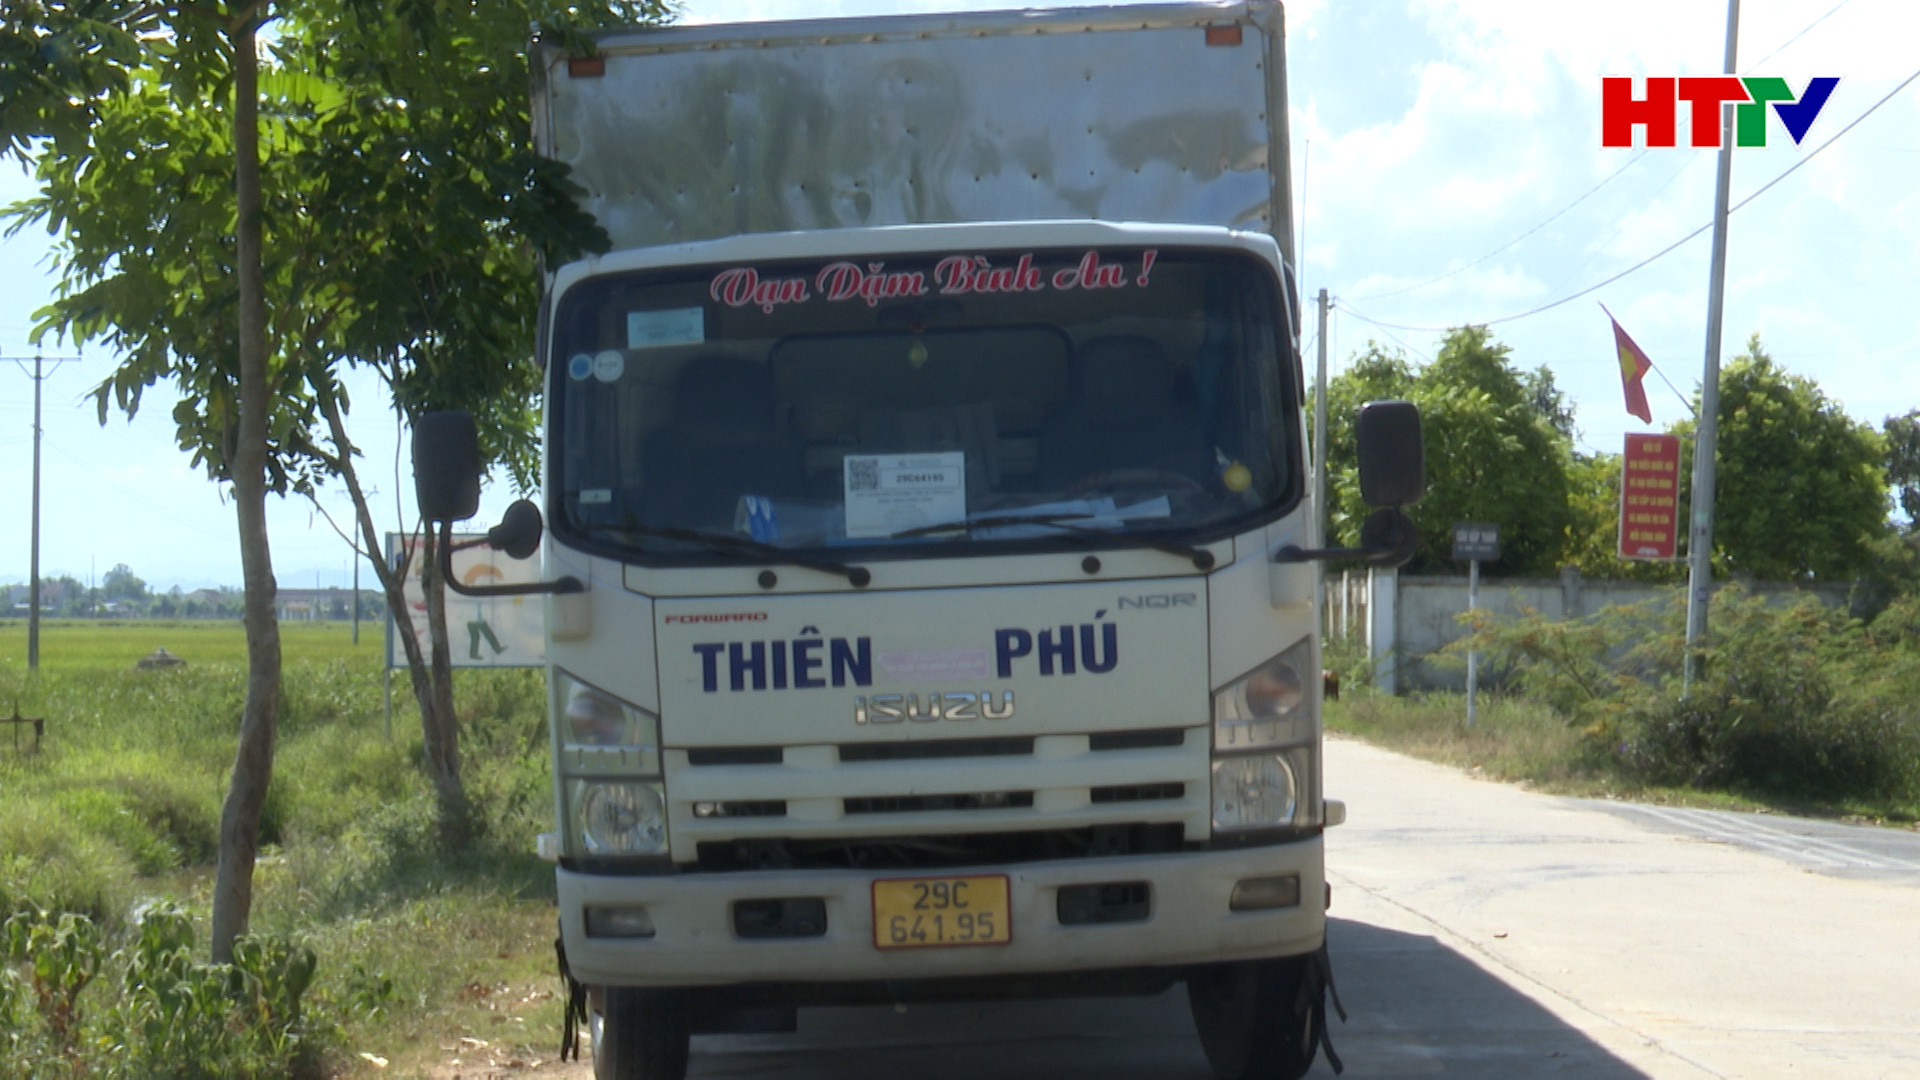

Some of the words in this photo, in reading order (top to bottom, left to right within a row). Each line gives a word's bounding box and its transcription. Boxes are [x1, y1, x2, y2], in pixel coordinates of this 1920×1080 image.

[710, 267, 810, 314] Vạn
[816, 261, 928, 308] Dặm
[935, 253, 1044, 295] Bình
[1052, 250, 1127, 290] An
[1137, 250, 1158, 287] !
[1117, 593, 1197, 610] NQR
[665, 612, 768, 624] FORWARD
[693, 625, 873, 692] THIÊN
[995, 609, 1118, 679] PHÚ
[854, 690, 1015, 725] ISUZU
[913, 881, 969, 910] 29C
[890, 912, 995, 943] 641.95
